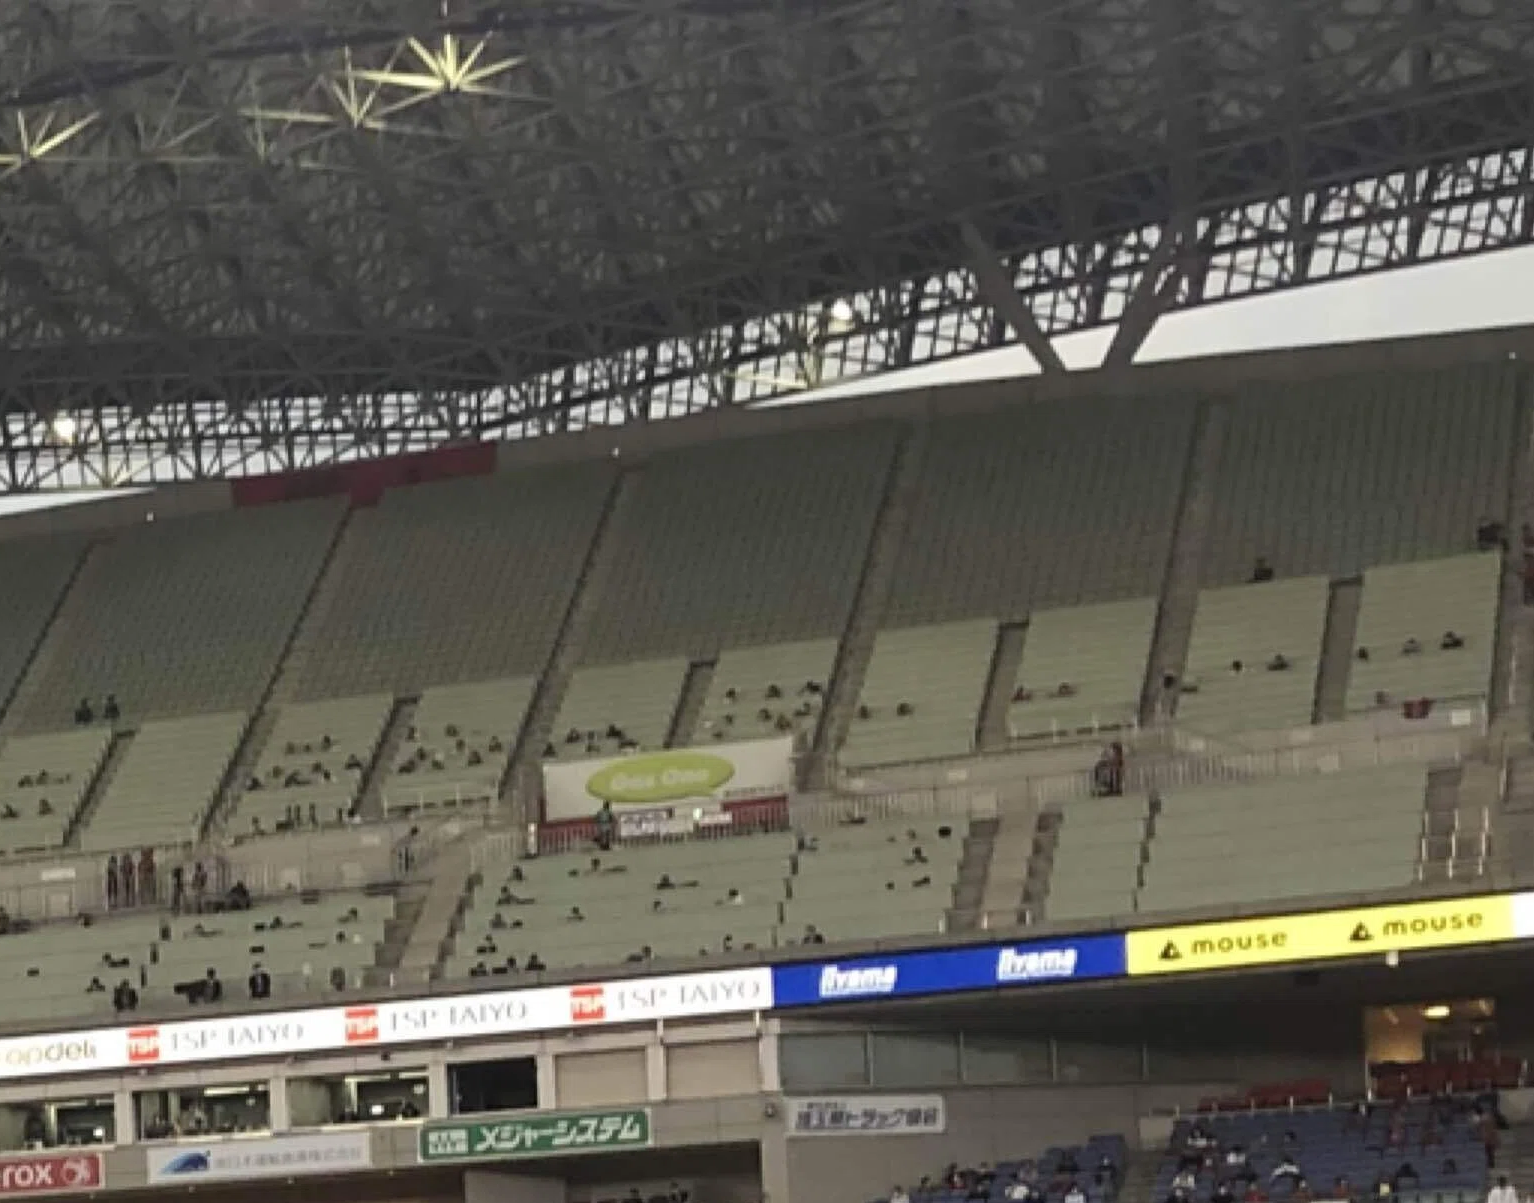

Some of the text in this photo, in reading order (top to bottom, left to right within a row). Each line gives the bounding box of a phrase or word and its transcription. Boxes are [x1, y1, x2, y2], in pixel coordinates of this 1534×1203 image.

[1382, 911, 1483, 936] mouse
[1191, 930, 1286, 955] mouse
[998, 948, 1077, 980] iiyama
[821, 964, 897, 997] iiyama
[617, 990, 668, 1012] TSP
[676, 981, 760, 1006] TAIYO
[390, 1010, 441, 1033] TSP
[449, 1002, 527, 1026] TAIYO
[170, 1031, 221, 1052] TSP
[227, 1023, 303, 1047] TAIYO
[476, 1116, 639, 1151] メジャーシステム
